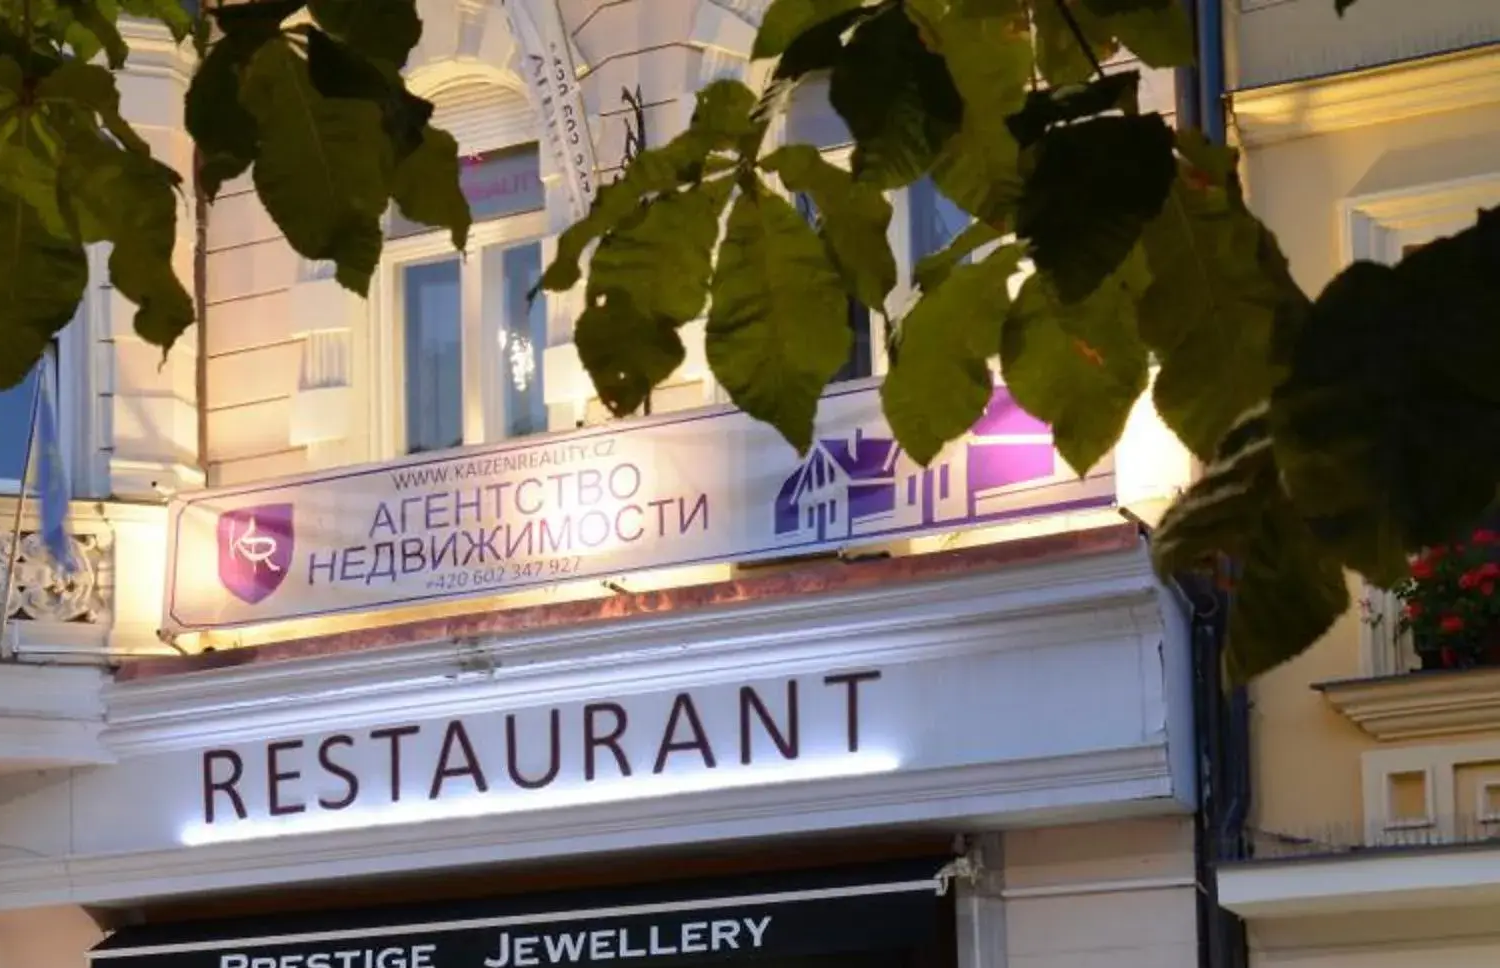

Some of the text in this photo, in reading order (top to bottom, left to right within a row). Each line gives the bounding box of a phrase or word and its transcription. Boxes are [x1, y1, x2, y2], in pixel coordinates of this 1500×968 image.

[368, 463, 642, 539] АГЕНТСТВО
[307, 492, 710, 587] НЕДВИЖИМОСТИ
[512, 560, 544, 580] 347
[202, 669, 882, 825] RESTAURANT
[484, 916, 773, 968] JEWELLERY
